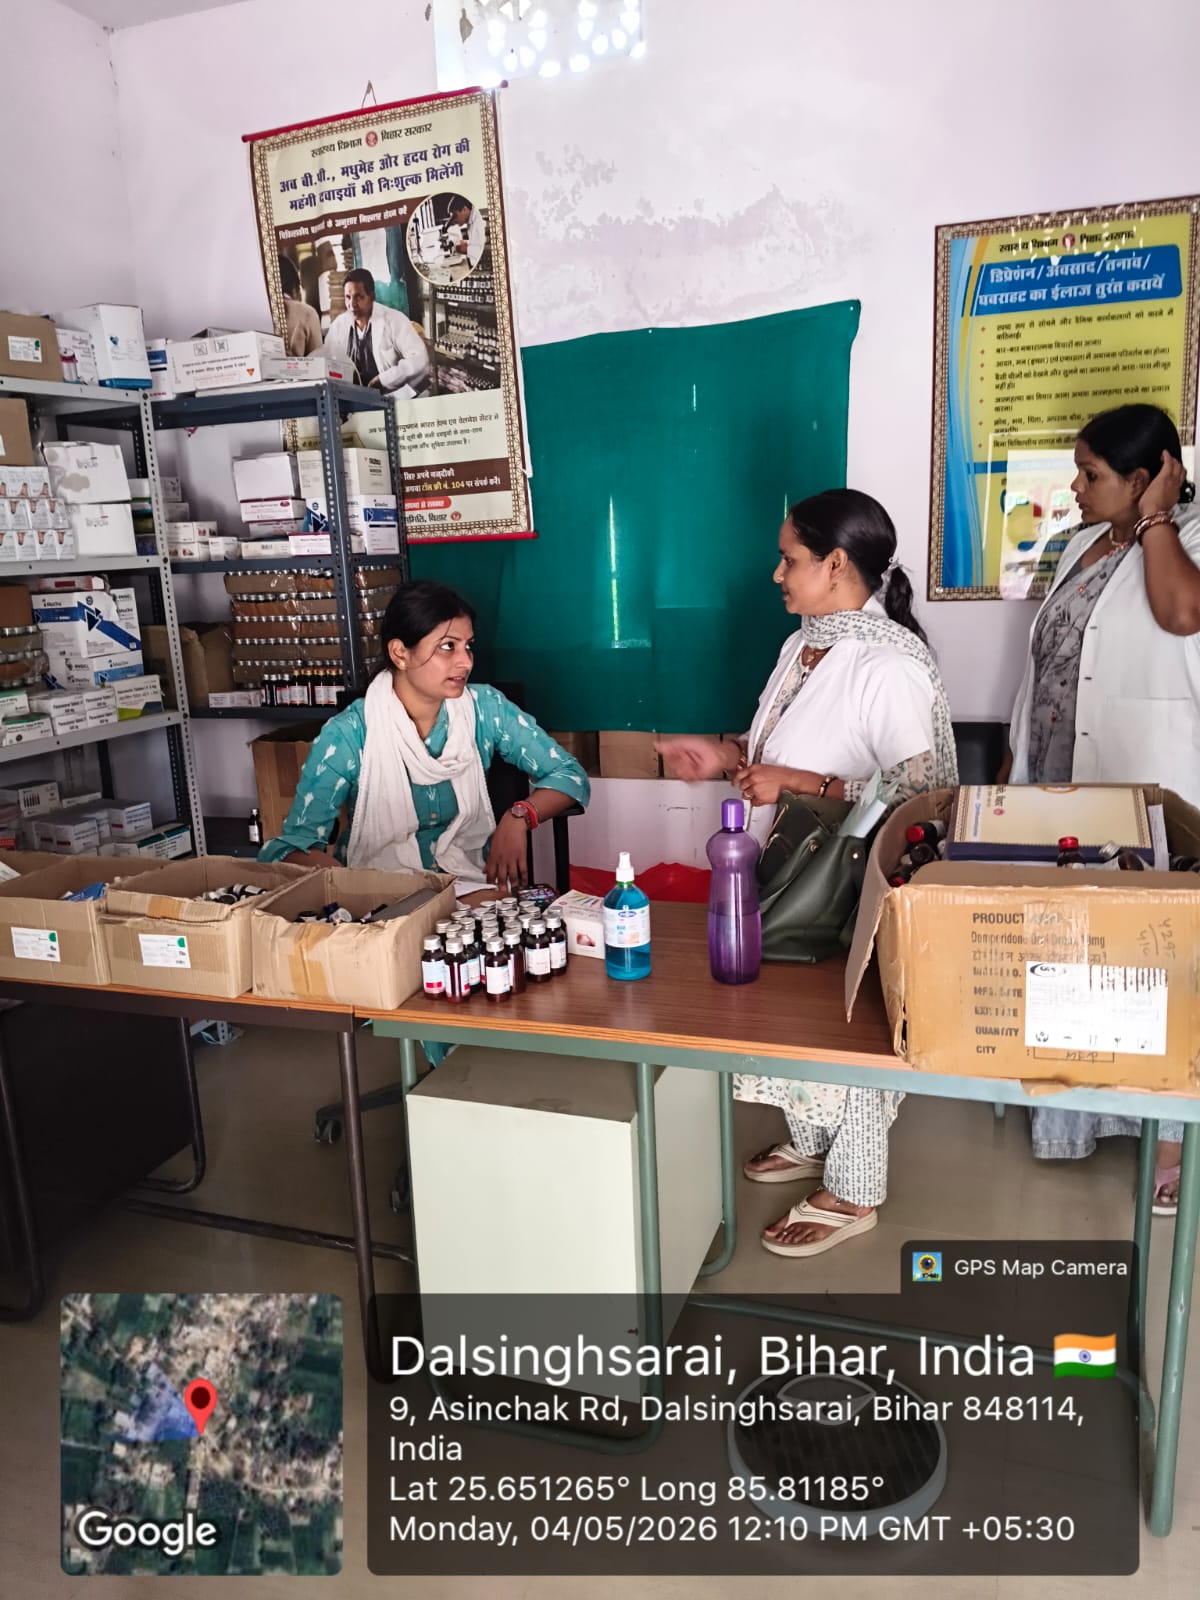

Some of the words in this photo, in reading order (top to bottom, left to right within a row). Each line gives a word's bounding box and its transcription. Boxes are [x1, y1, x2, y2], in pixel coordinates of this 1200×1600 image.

[337, 138, 362, 151] विभाग
[381, 127, 403, 142] बिहार
[404, 123, 433, 137] सरकार
[280, 178, 297, 193] अब
[340, 160, 375, 181] मधुमेह
[379, 152, 399, 170] और
[432, 143, 451, 159] रोग
[455, 137, 471, 153] की
[289, 193, 316, 211] महंगी
[361, 180, 374, 195] भी
[425, 161, 464, 183] मिलेंगी
[1029, 288, 1048, 301] का
[1051, 283, 1092, 301] ईलाज
[1095, 278, 1123, 299] तुरंत
[452, 481, 465, 489] 104
[972, 912, 1025, 924] PRODUCT
[976, 1045, 997, 1054] CITY
